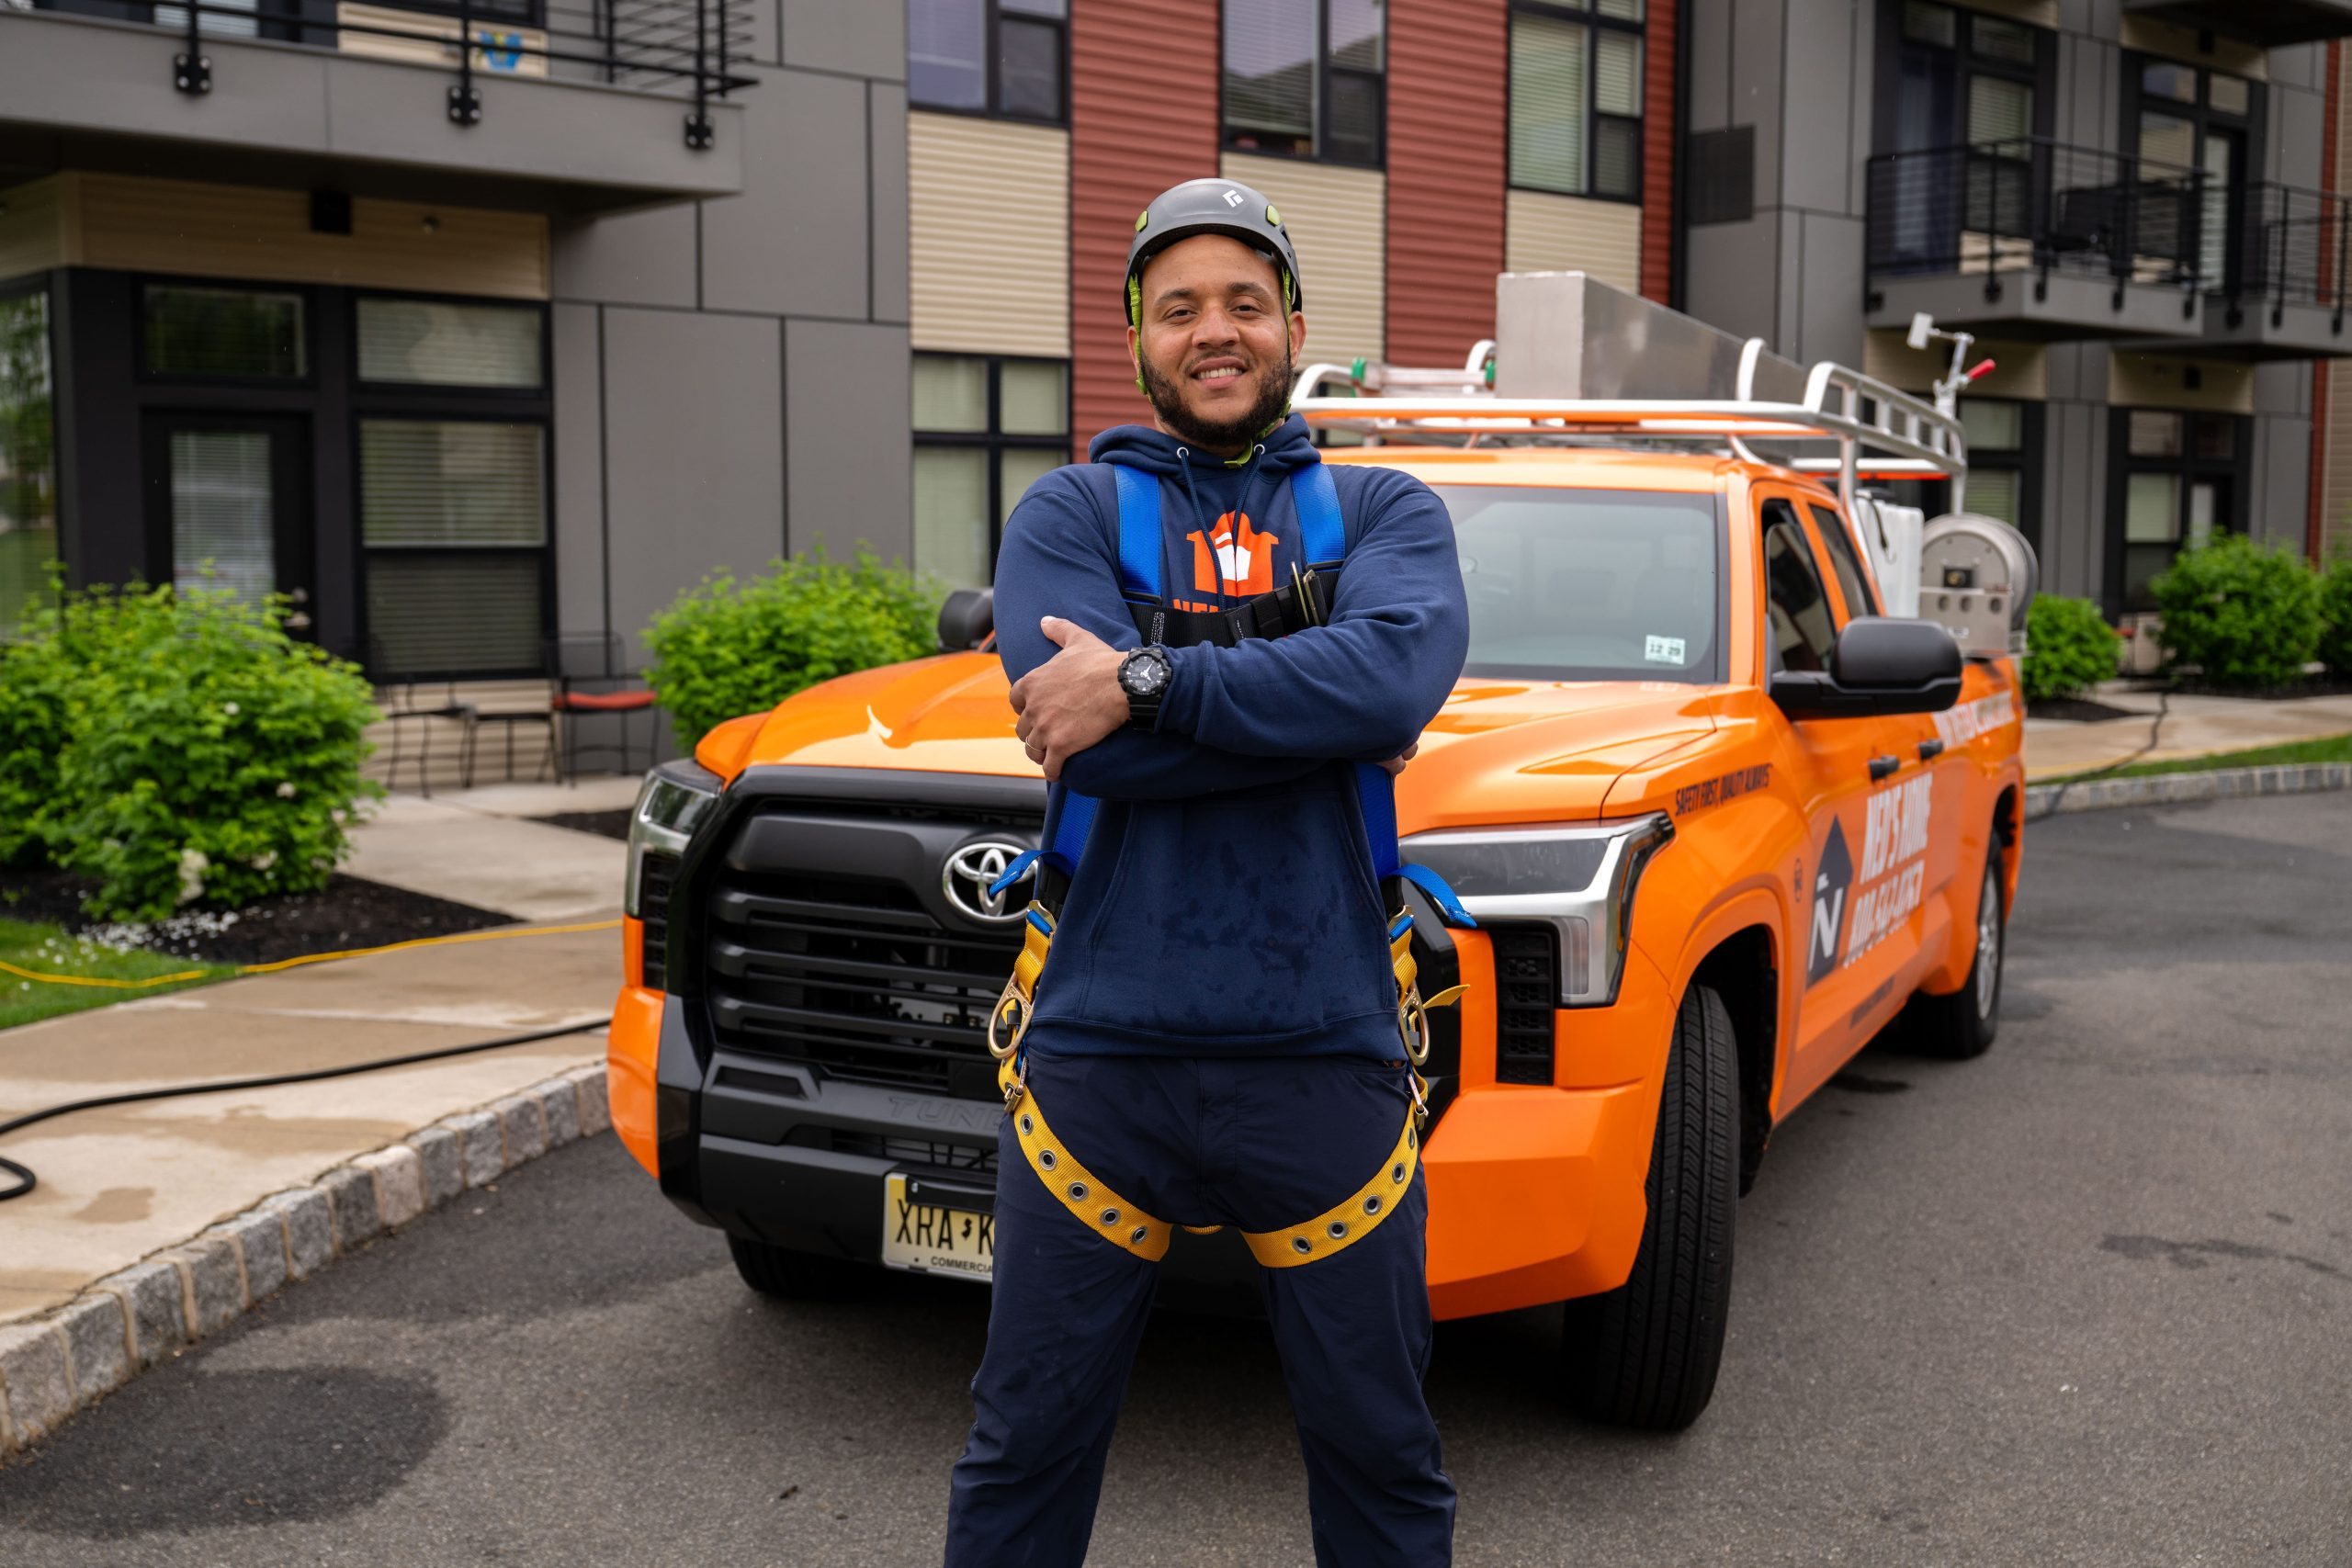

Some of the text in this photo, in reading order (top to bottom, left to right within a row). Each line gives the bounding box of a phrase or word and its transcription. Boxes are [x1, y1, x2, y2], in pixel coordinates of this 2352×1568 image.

[1675, 782, 1700, 818] SAFETY
[1808, 887, 1844, 972] N
[896, 1198, 953, 1250] XRA
